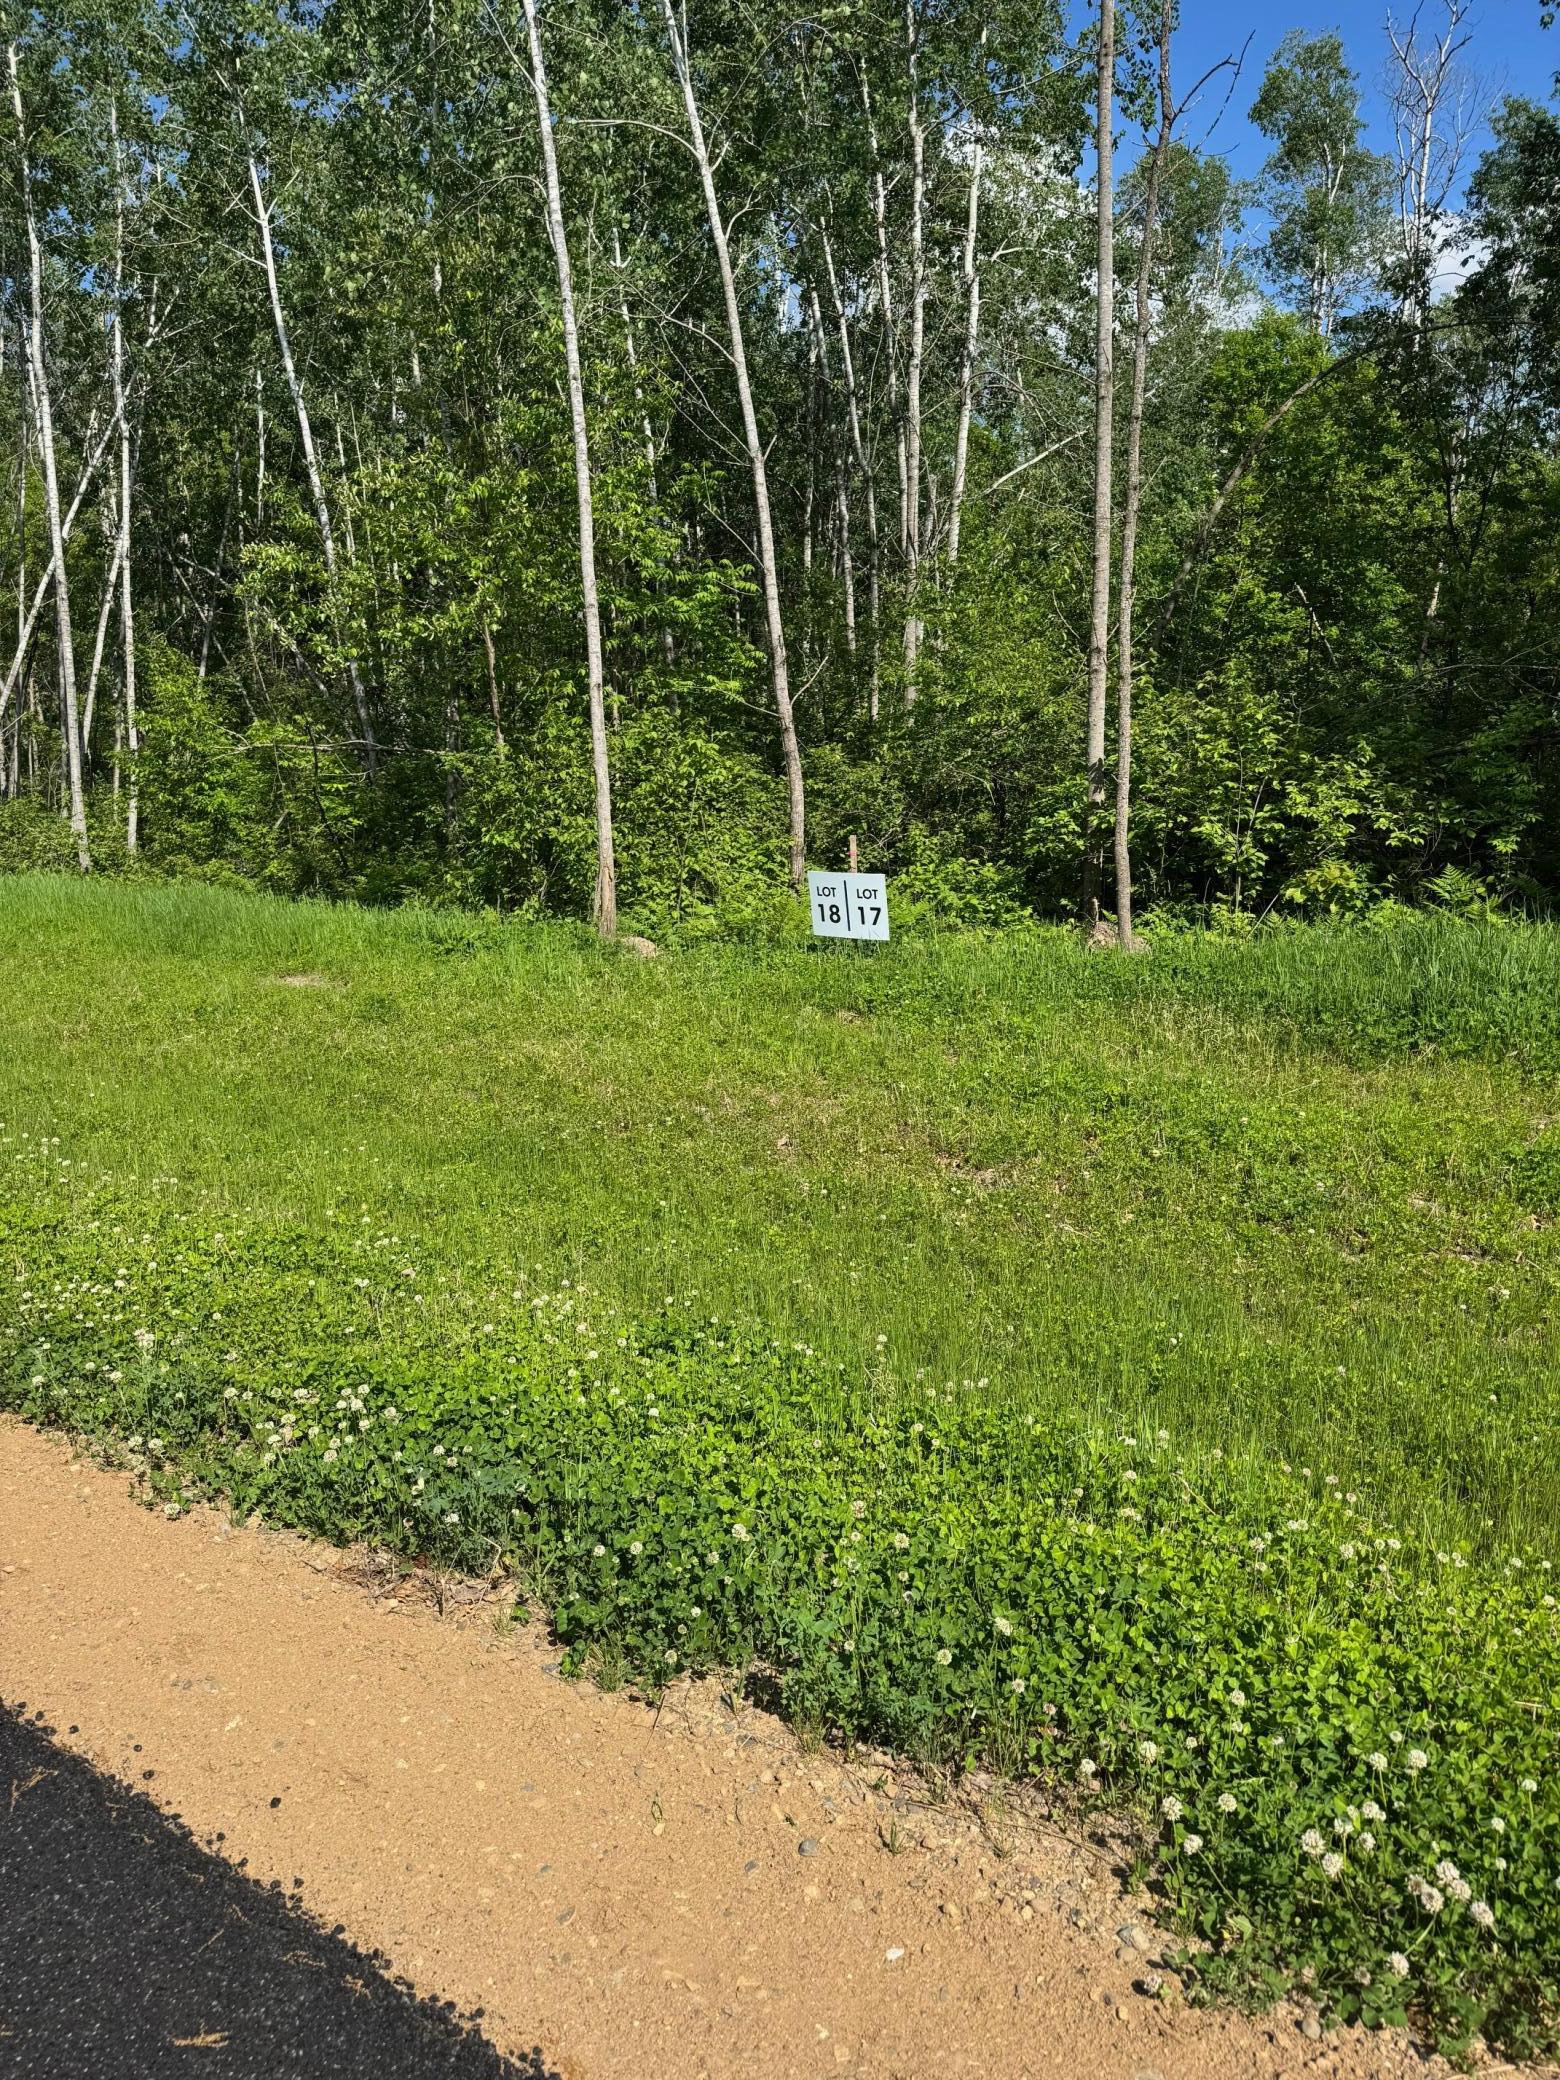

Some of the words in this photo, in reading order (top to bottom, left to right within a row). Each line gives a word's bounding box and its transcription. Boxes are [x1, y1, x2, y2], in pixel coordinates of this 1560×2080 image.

[816, 886, 837, 897] LOT
[856, 888, 878, 899] LOT
[818, 903, 841, 923] 18
[857, 906, 881, 925] 17
